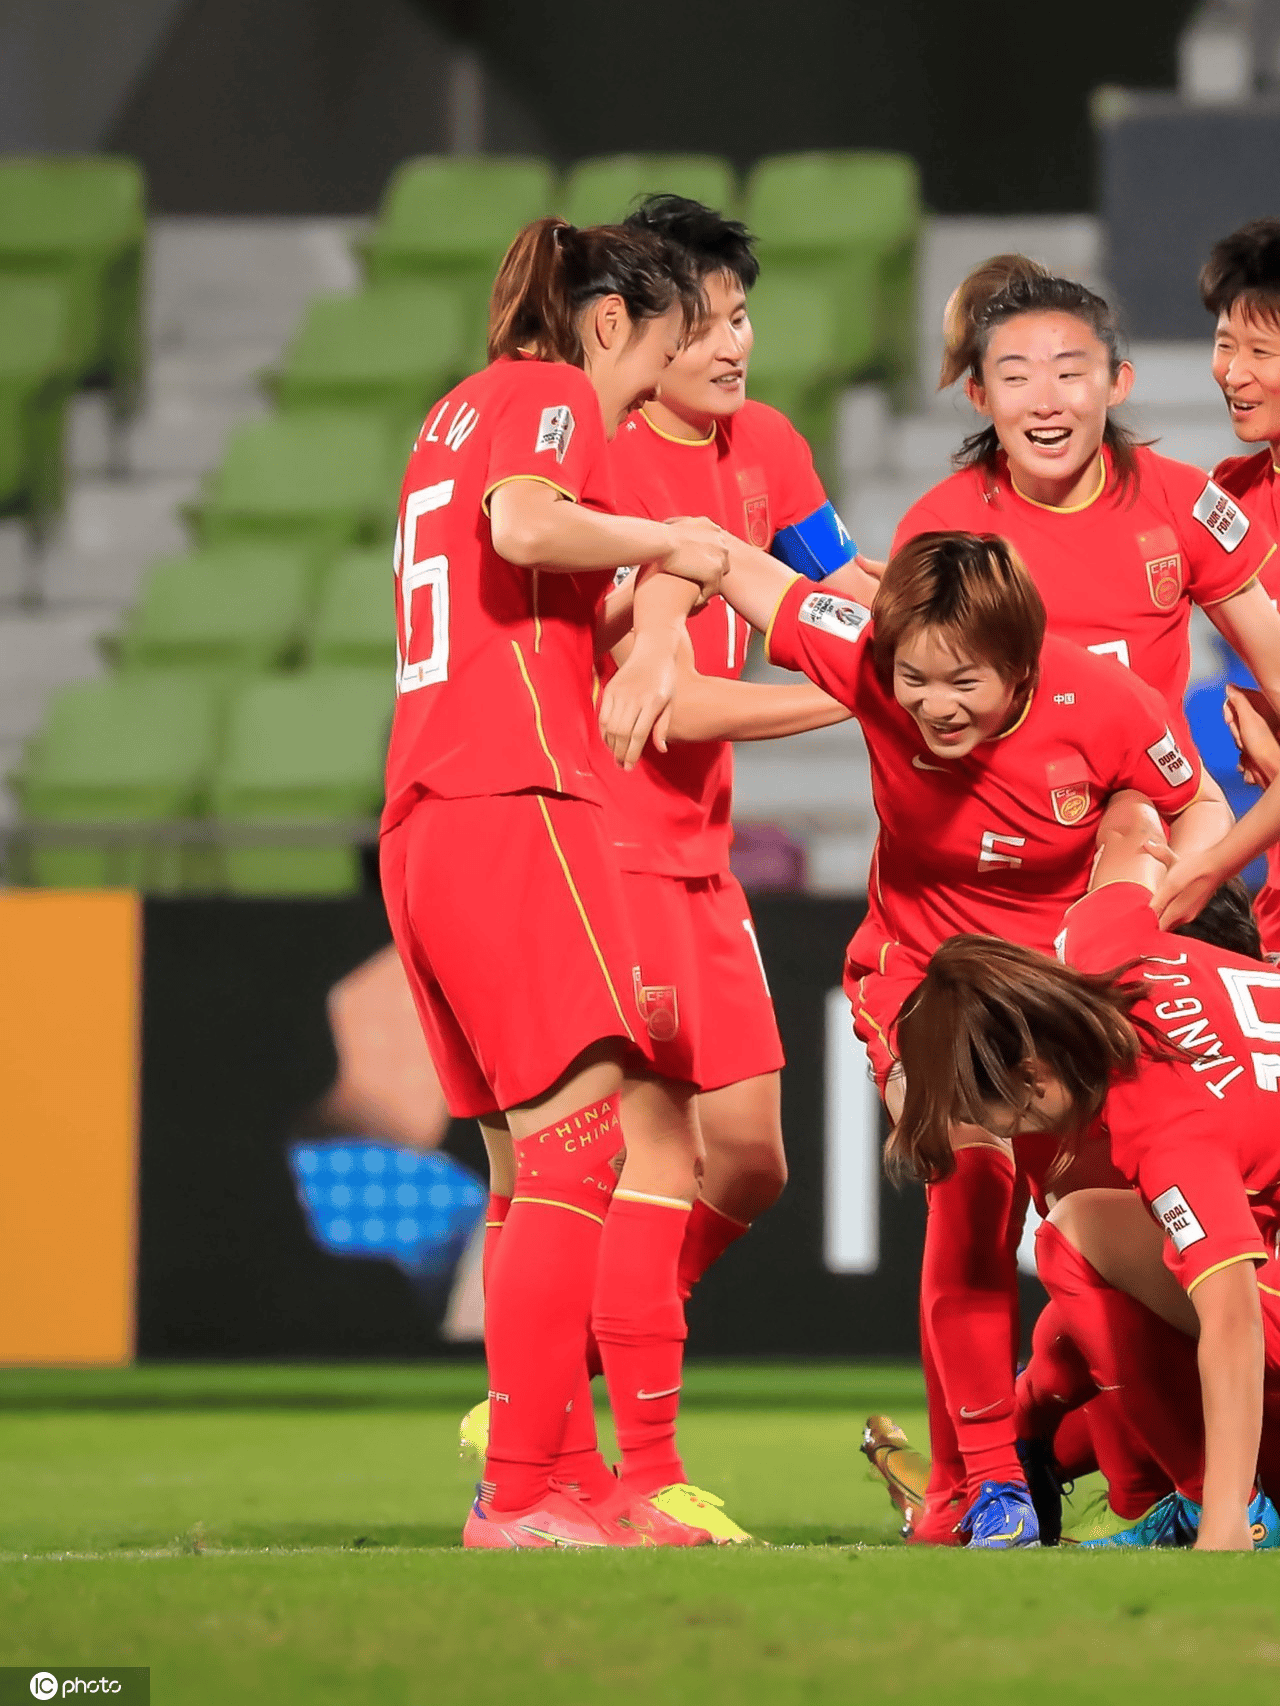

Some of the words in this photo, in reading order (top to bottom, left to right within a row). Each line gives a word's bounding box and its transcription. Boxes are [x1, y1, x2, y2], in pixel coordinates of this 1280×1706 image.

[1206, 511, 1221, 528] OUR
[1216, 517, 1232, 535] FOR
[1150, 559, 1177, 575] CFA
[1158, 750, 1177, 766] OUR
[1167, 757, 1184, 773] FOR
[1154, 996, 1245, 1101] TANG
[564, 1114, 620, 1153] CHINA
[1163, 1204, 1188, 1224] GOAL
[1172, 1216, 1191, 1233] ALL
